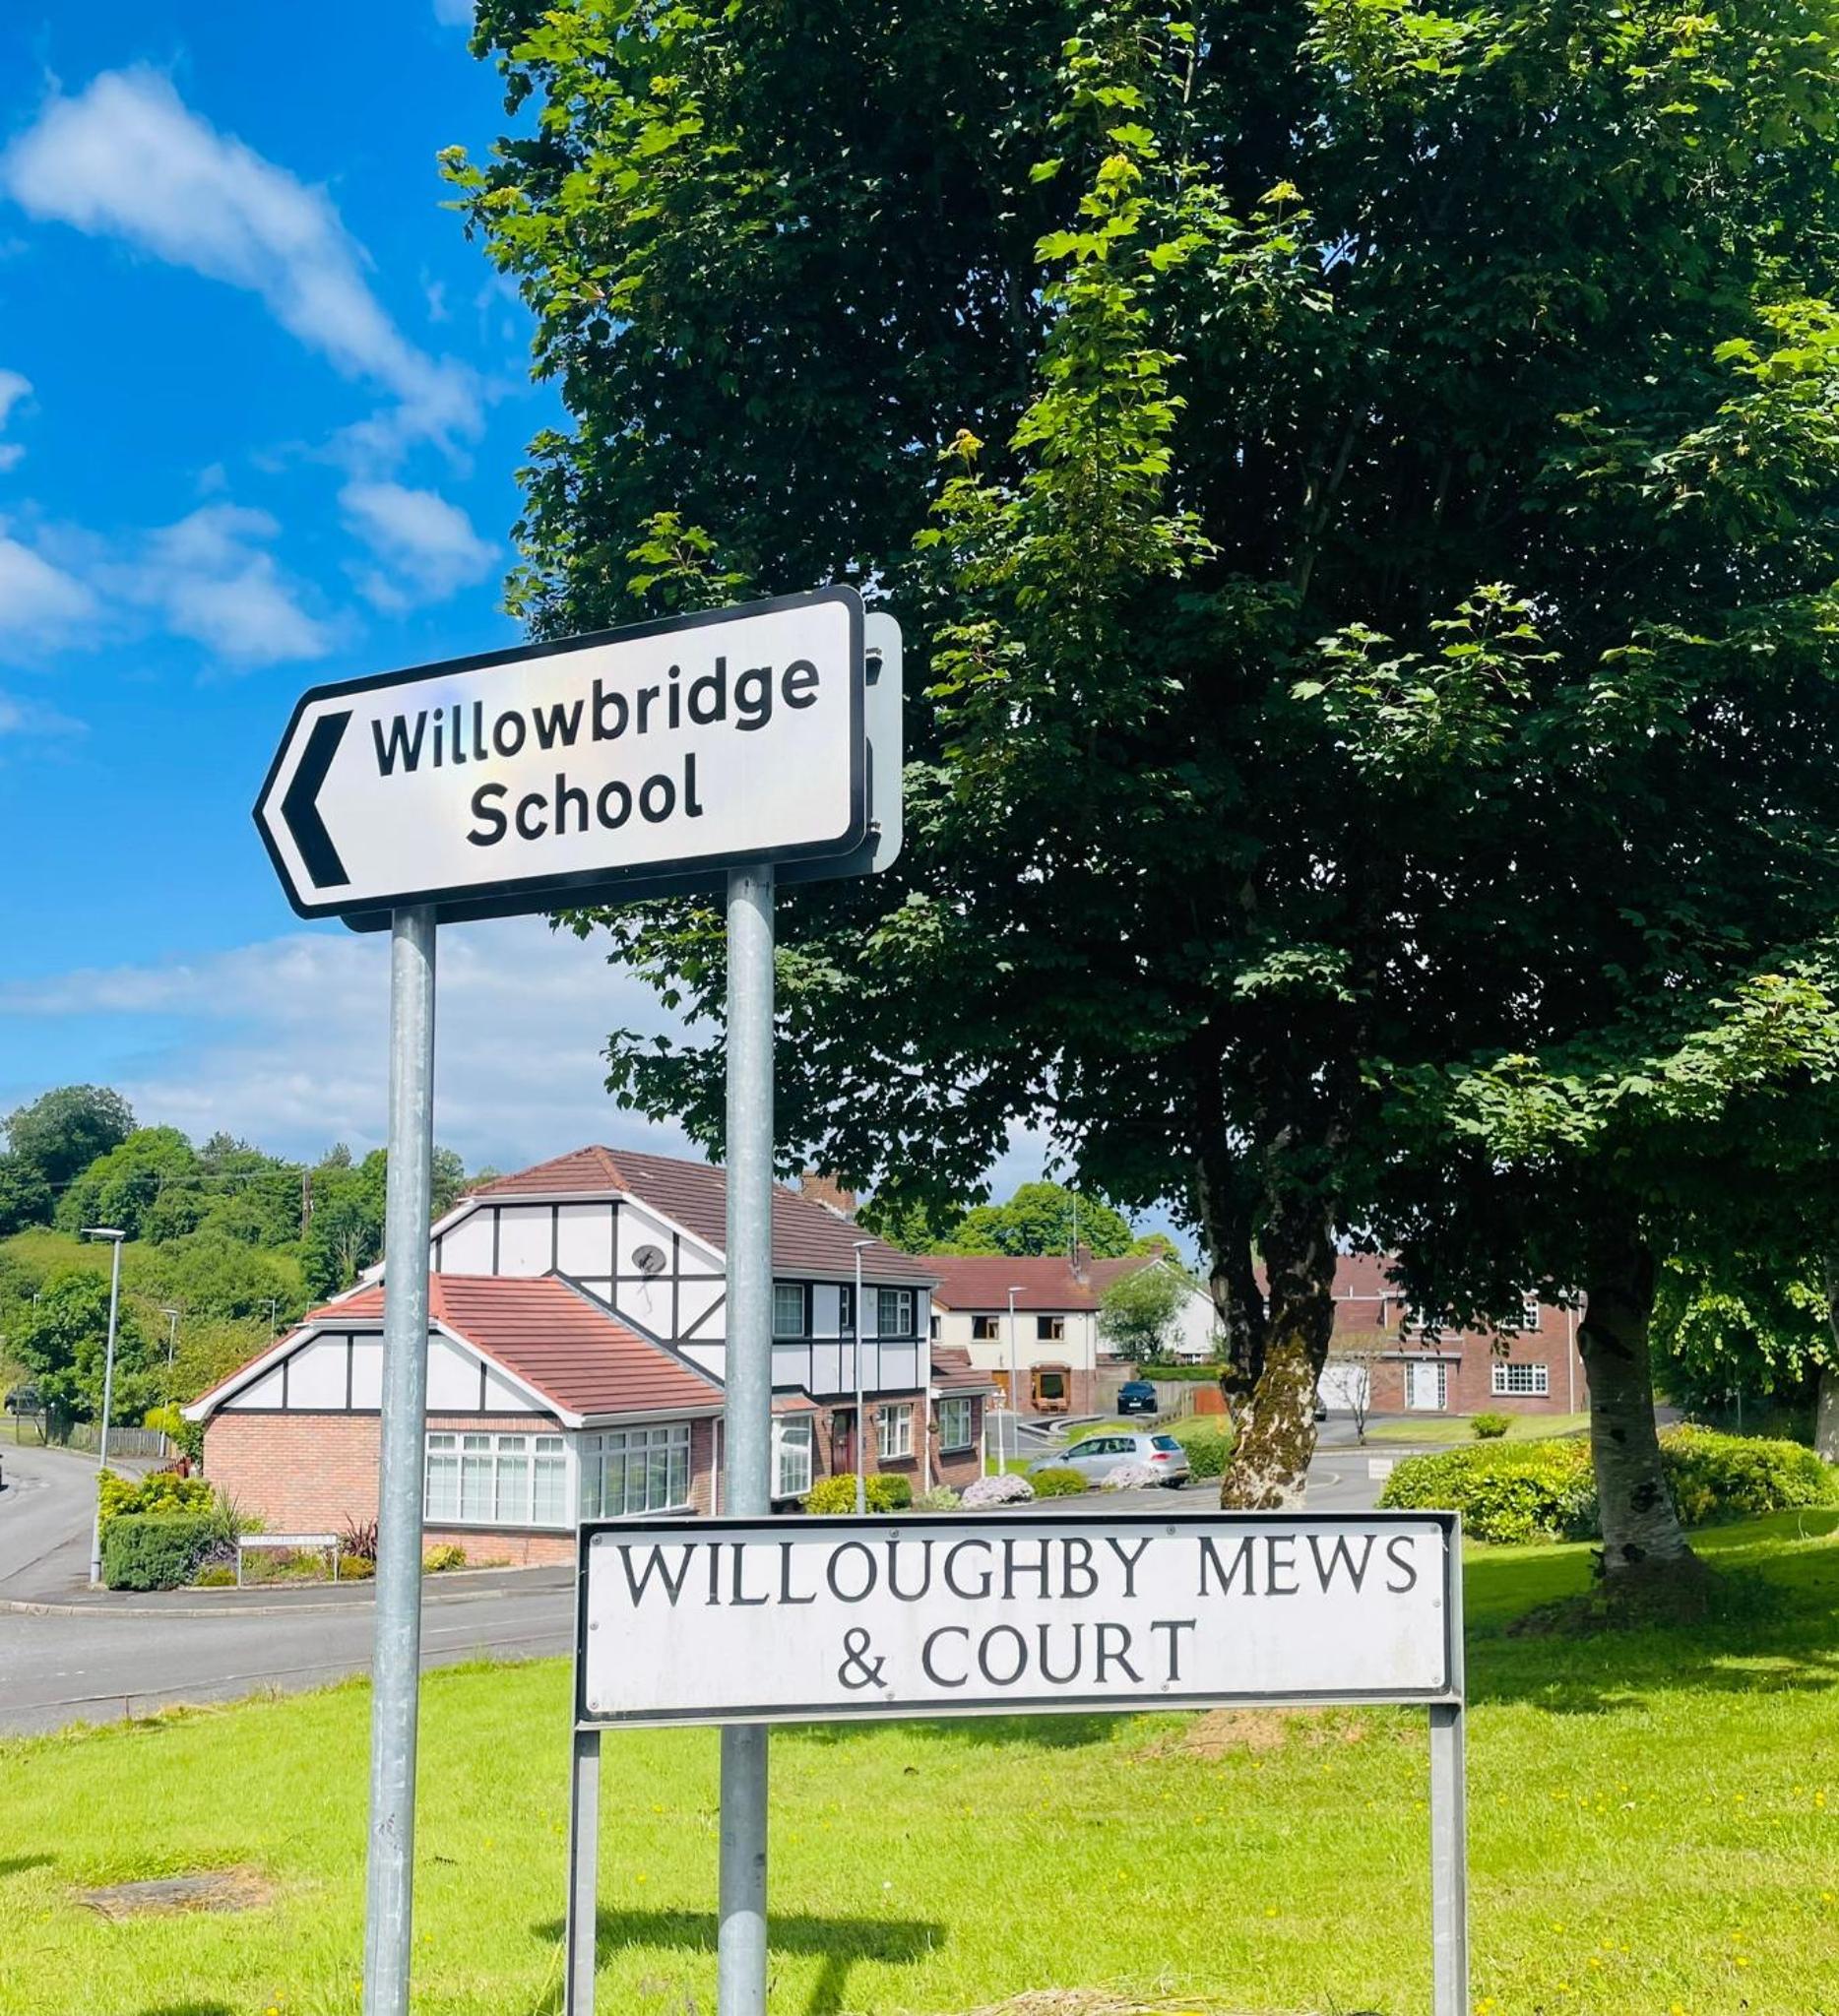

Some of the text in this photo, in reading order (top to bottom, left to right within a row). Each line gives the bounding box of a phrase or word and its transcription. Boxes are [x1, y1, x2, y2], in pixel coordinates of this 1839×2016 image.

[372, 657, 819, 777] Willowbridge
[467, 753, 702, 847] School
[617, 1535, 1416, 1606] WILLOUGHBY MEWS
[839, 1619, 1195, 1688] & COURT
